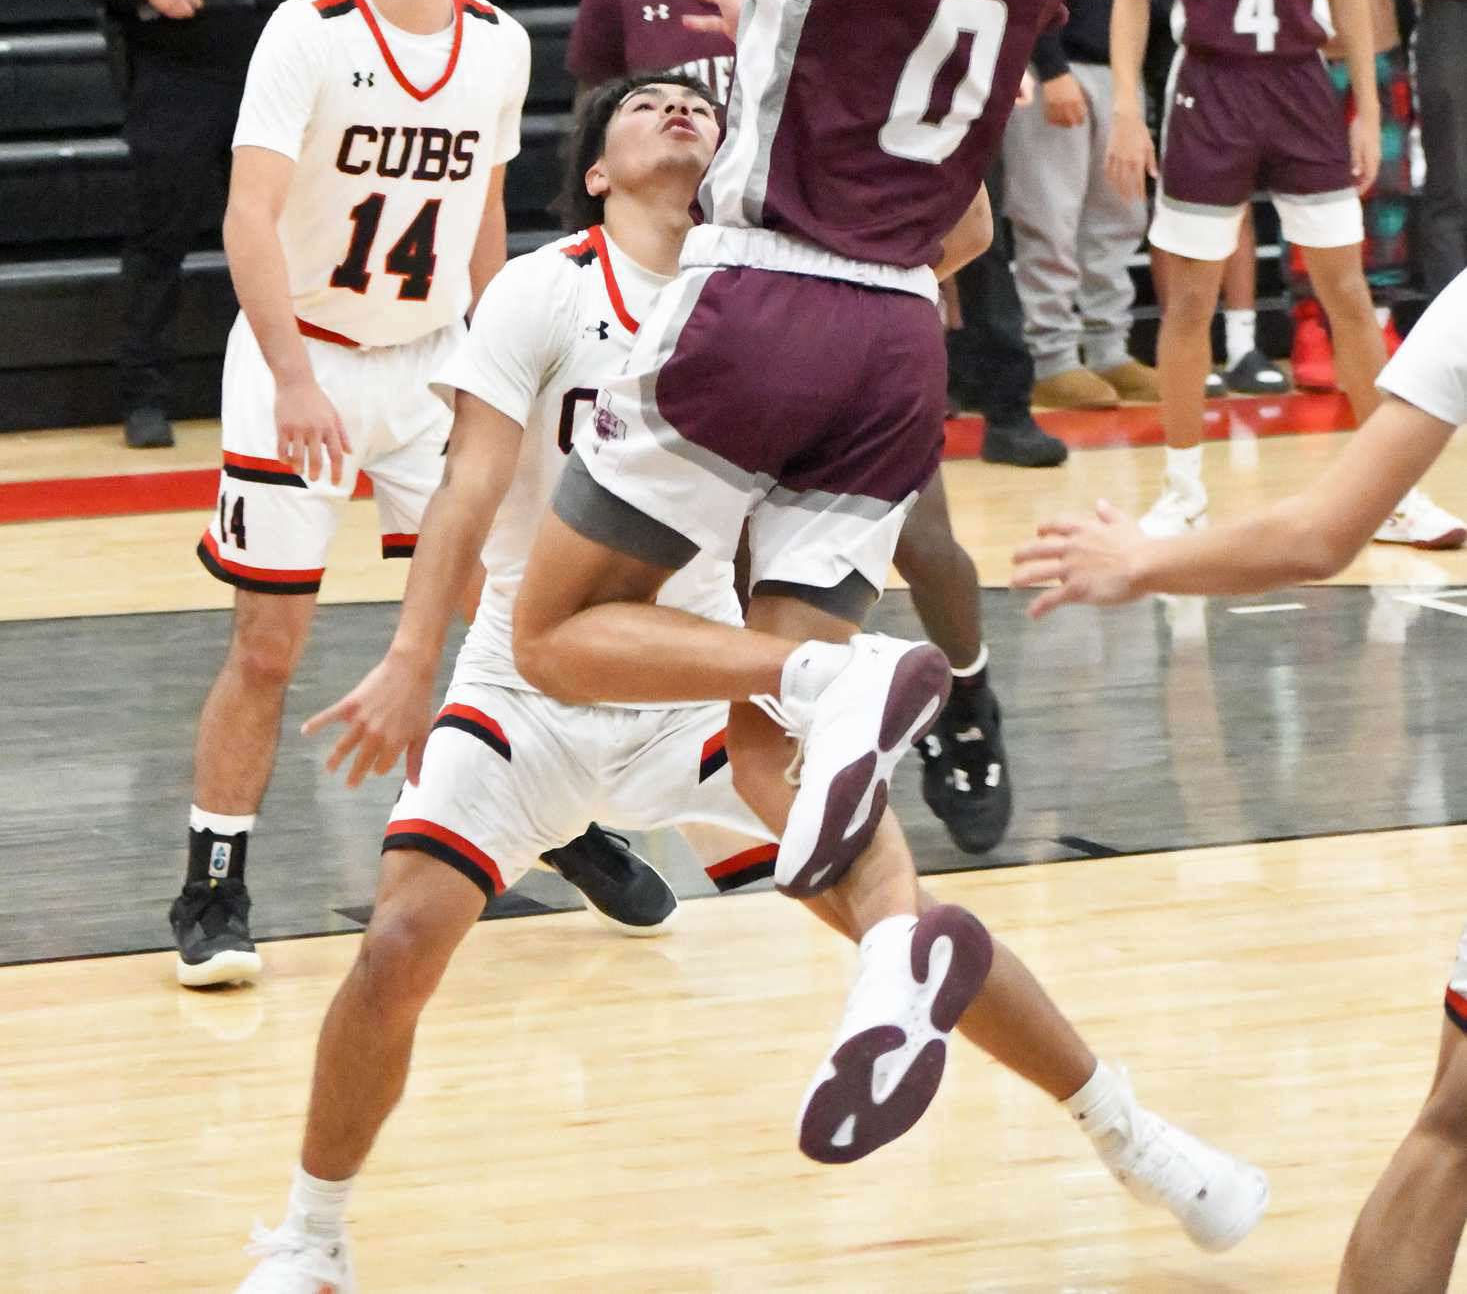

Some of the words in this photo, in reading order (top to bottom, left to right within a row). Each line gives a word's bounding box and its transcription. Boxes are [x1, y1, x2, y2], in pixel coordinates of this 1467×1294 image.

[336, 124, 480, 182] CUBS
[329, 192, 442, 301] 14
[220, 491, 246, 551] 14
